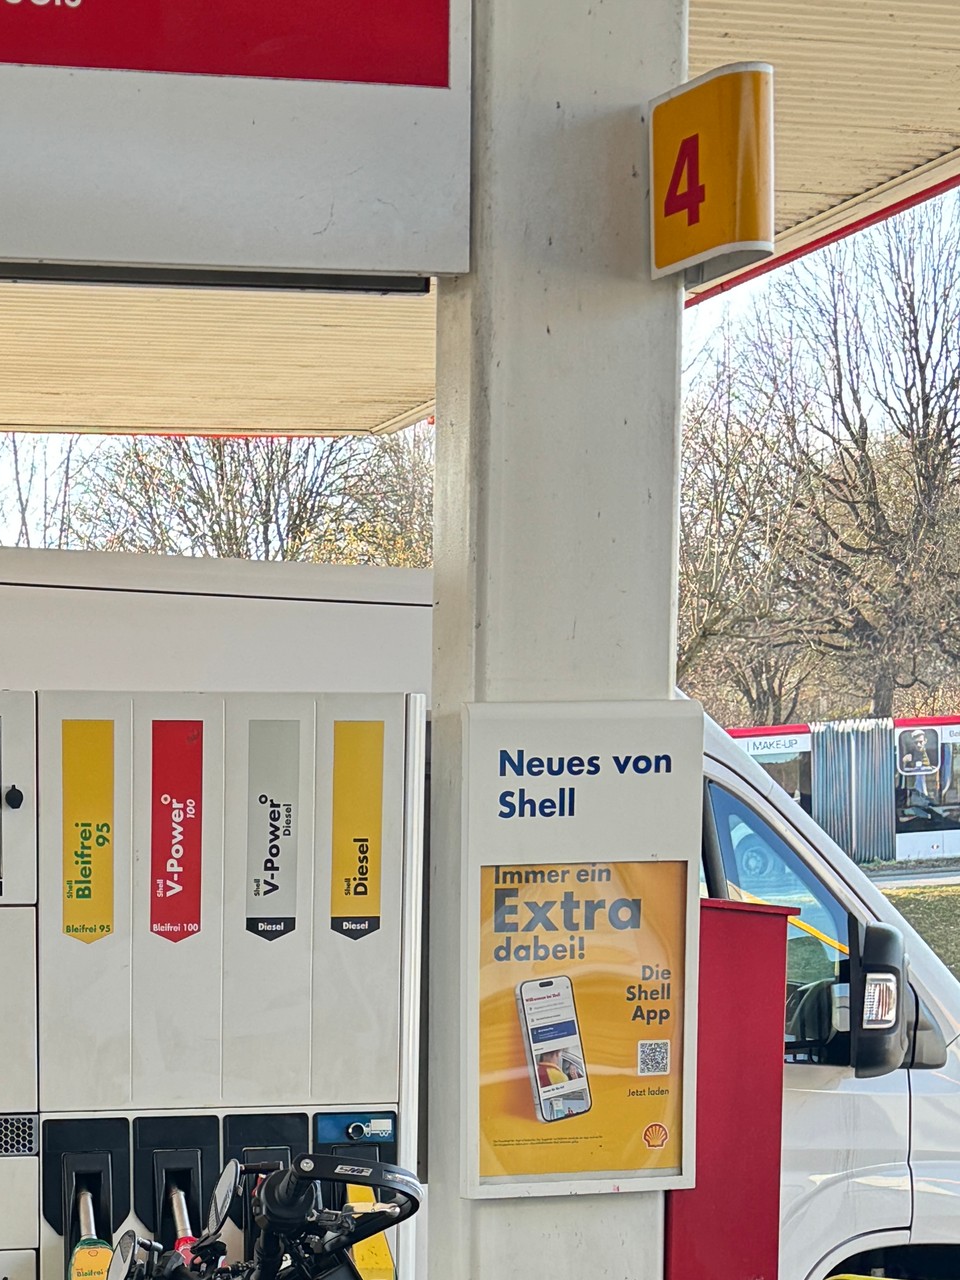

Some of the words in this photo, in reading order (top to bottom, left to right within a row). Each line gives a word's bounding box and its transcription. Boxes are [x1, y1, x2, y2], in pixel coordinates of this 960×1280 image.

[664, 133, 706, 227] 4
[752, 739, 799, 750] MAKE-UP
[499, 750, 601, 777] Neues
[612, 754, 672, 774] von
[187, 799, 195, 819] 100
[498, 787, 576, 819] Shell
[283, 803, 291, 837] Diesel
[96, 822, 111, 847] 95
[166, 799, 184, 897] V-Power
[263, 799, 281, 896] V-Power
[75, 822, 91, 900] Bleifrei
[353, 838, 369, 896] Diesel
[494, 865, 569, 885] Immer
[576, 863, 611, 883] ein
[494, 888, 642, 933] Extra
[65, 924, 97, 933] Bleifrei
[99, 924, 111, 933] 95
[153, 923, 180, 932] Bleifrei
[182, 923, 198, 932] 100
[258, 922, 284, 931] Diesel
[343, 921, 368, 930] Diesel
[494, 935, 585, 962] dabei!
[641, 964, 672, 981] Die
[626, 983, 672, 1002] Shell
[631, 1006, 671, 1025] App
[627, 1088, 646, 1097] Jetzt
[648, 1087, 670, 1096] laden
